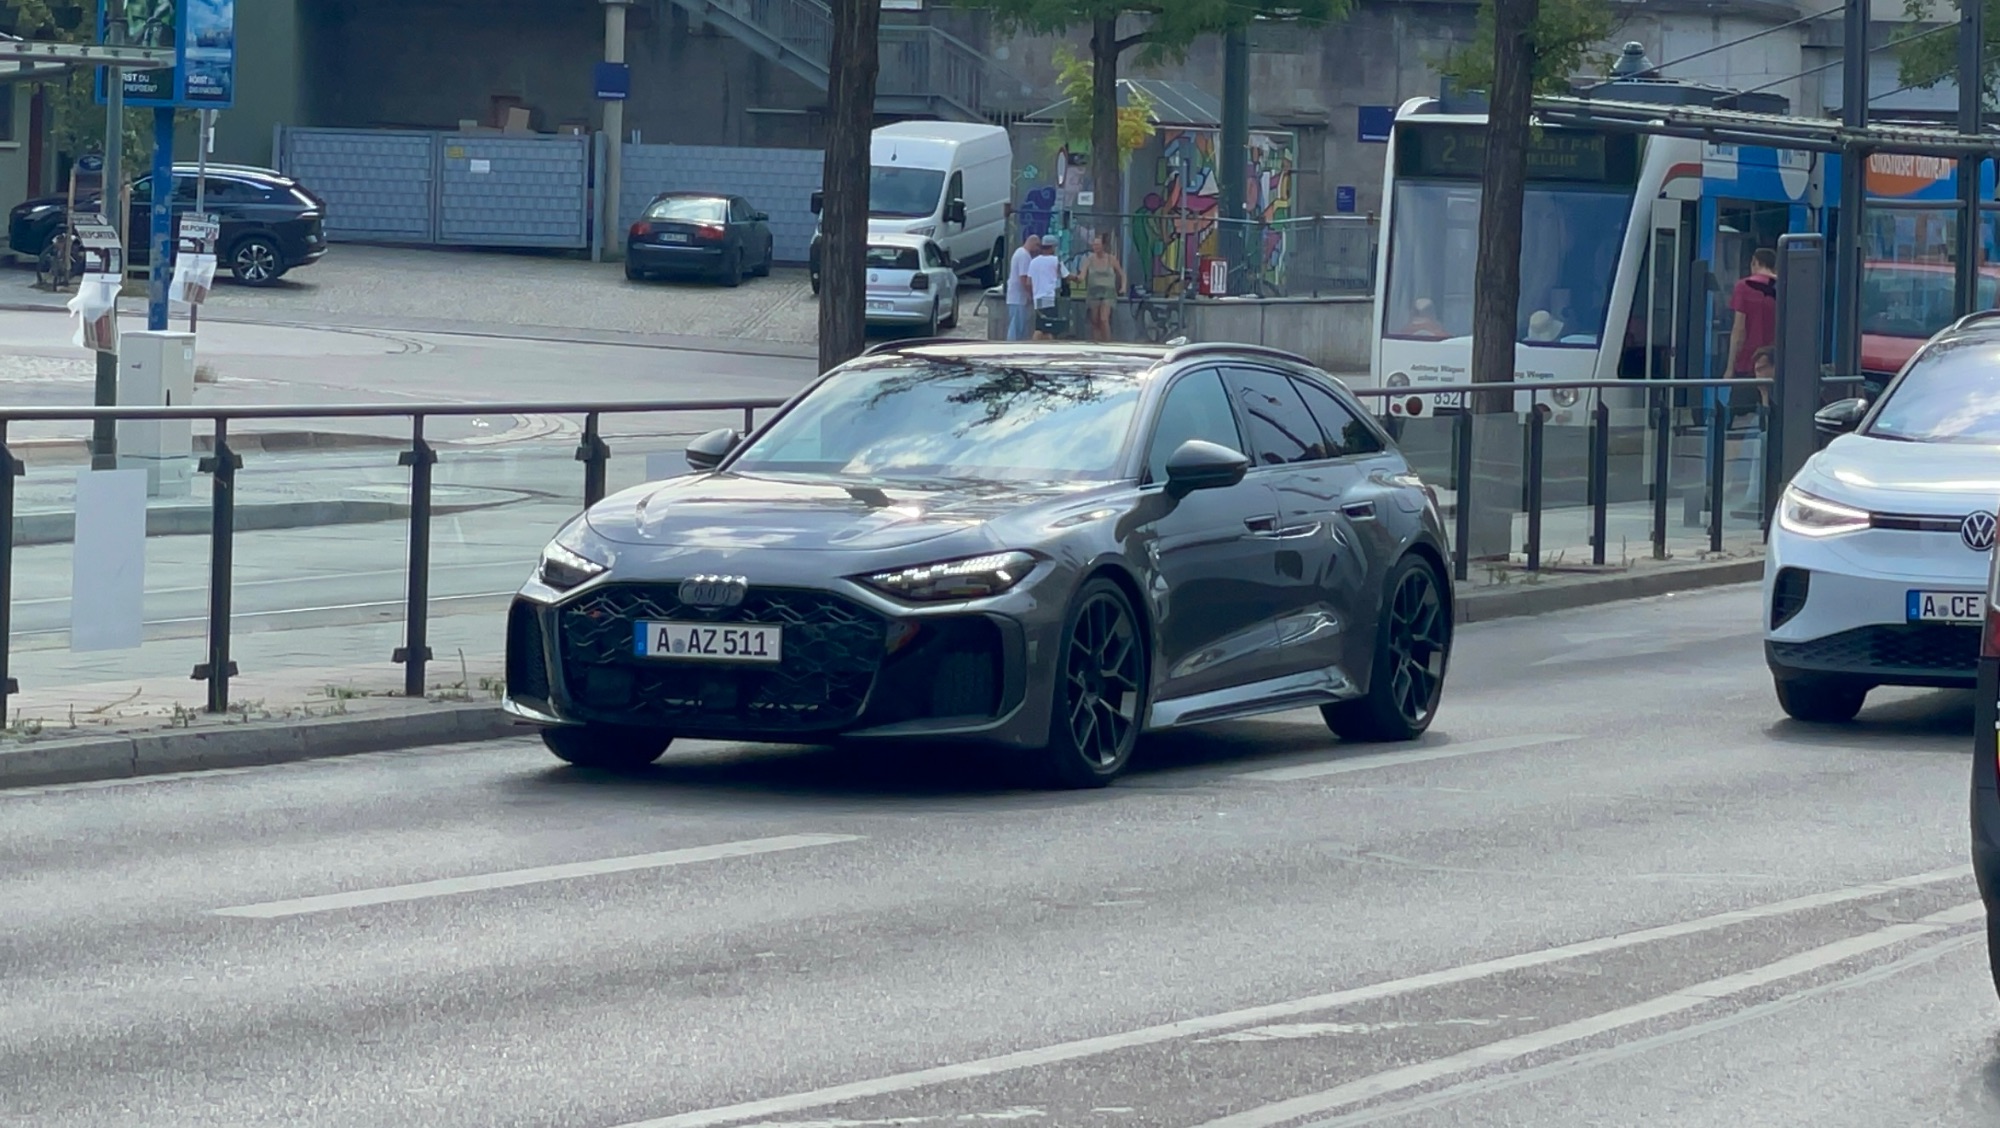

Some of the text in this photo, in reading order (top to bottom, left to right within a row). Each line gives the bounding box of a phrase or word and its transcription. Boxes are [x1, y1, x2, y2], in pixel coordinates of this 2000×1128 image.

[1442, 135, 1457, 163] 2
[1440, 365, 1465, 373] Wagen
[1526, 370, 1554, 380] Wagen
[1433, 391, 1459, 406] 852
[1923, 595, 1980, 618] A CE
[657, 627, 768, 656] A AZ 511
